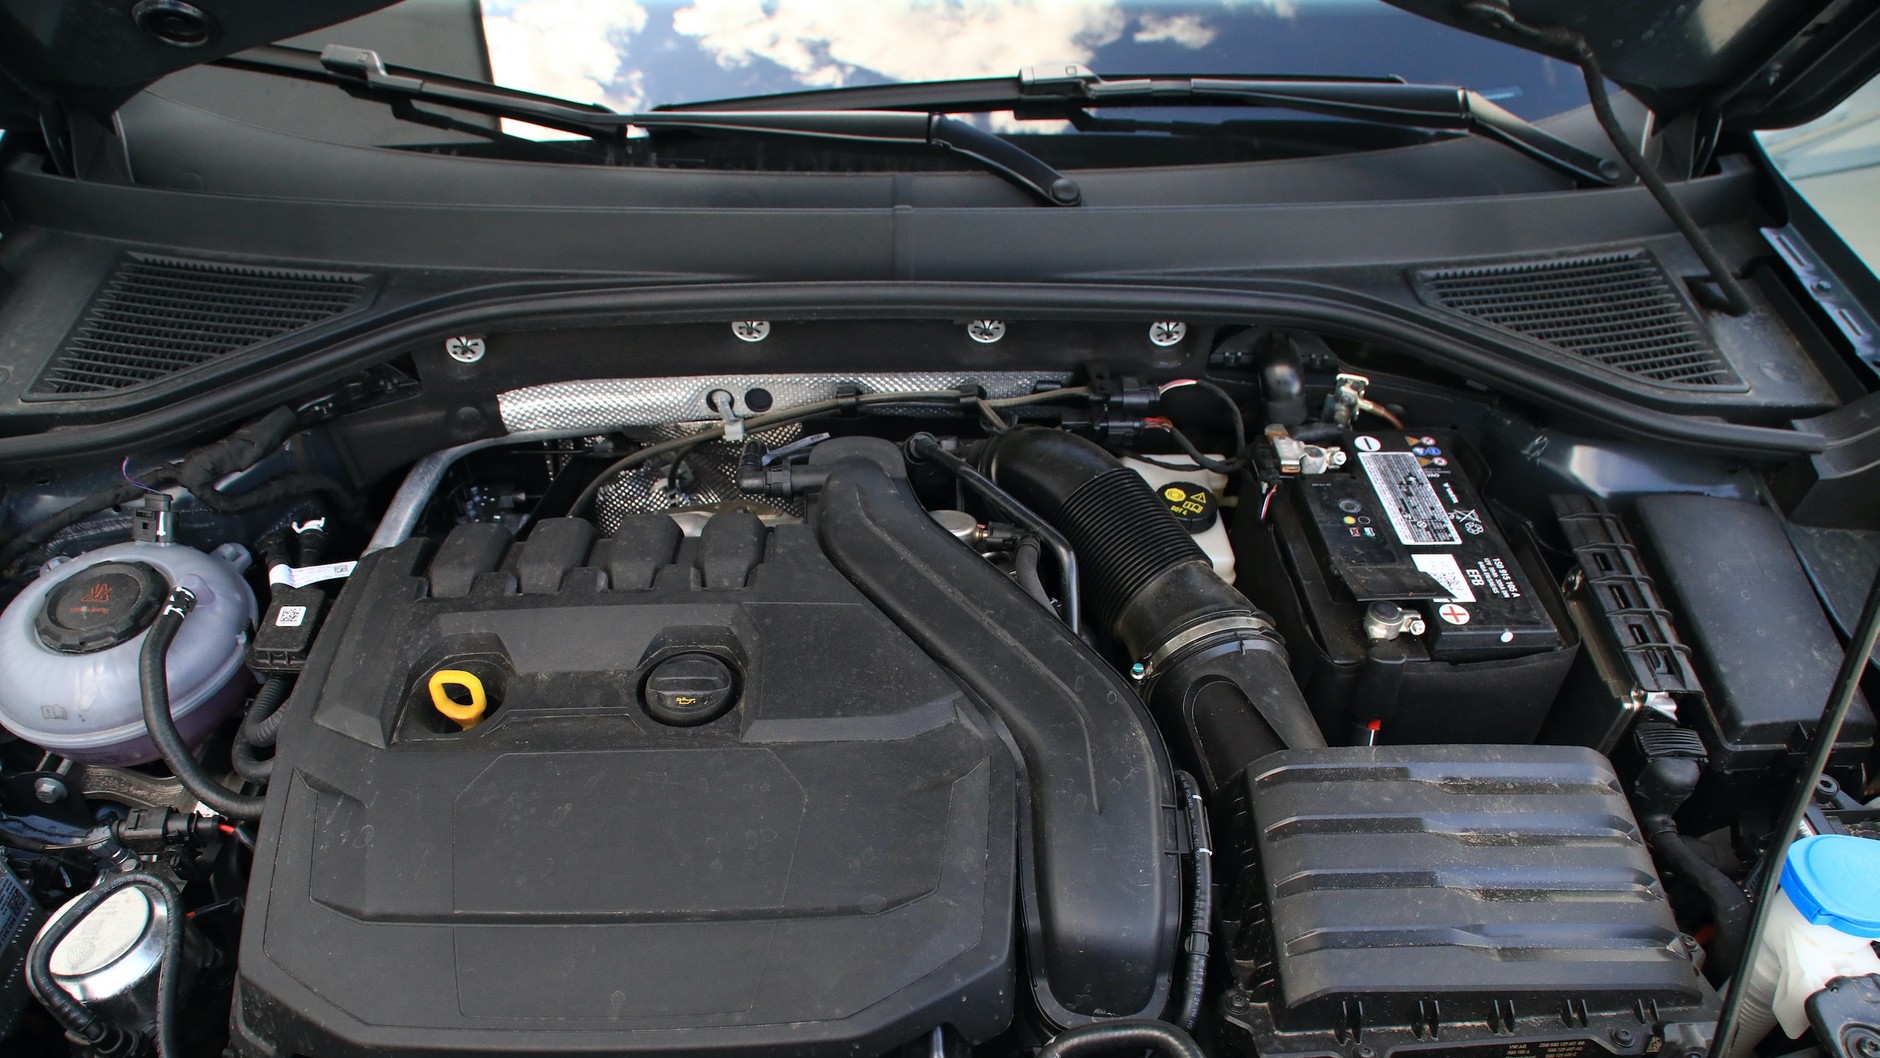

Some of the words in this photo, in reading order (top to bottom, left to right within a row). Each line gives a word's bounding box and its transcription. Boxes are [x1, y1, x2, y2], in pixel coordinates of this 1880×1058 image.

[1170, 505, 1183, 514] DOT
[1465, 569, 1485, 586] EFB
[1499, 569, 1511, 580] 915
[1505, 581, 1518, 592] 105
